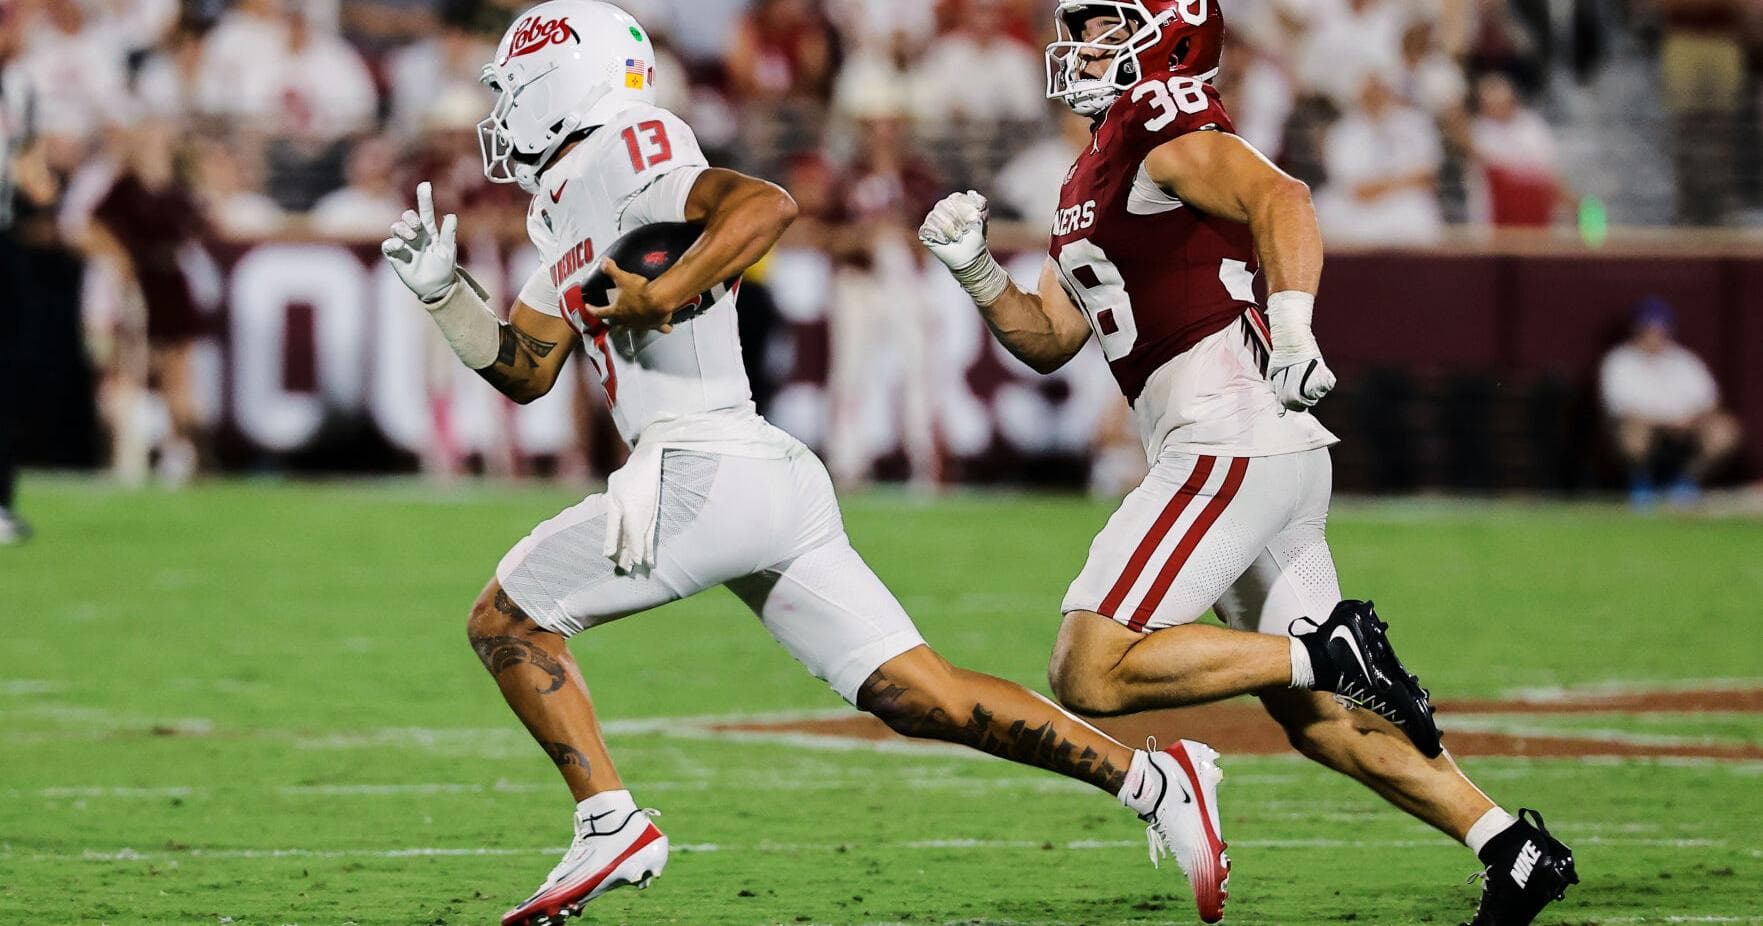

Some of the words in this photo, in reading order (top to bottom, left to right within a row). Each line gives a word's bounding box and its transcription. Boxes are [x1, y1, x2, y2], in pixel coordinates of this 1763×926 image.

[500, 16, 575, 67] Lobos
[1131, 76, 1209, 131] 38
[621, 119, 673, 174] 13
[1051, 238, 1138, 362] 8
[1510, 839, 1542, 889] NIKE
